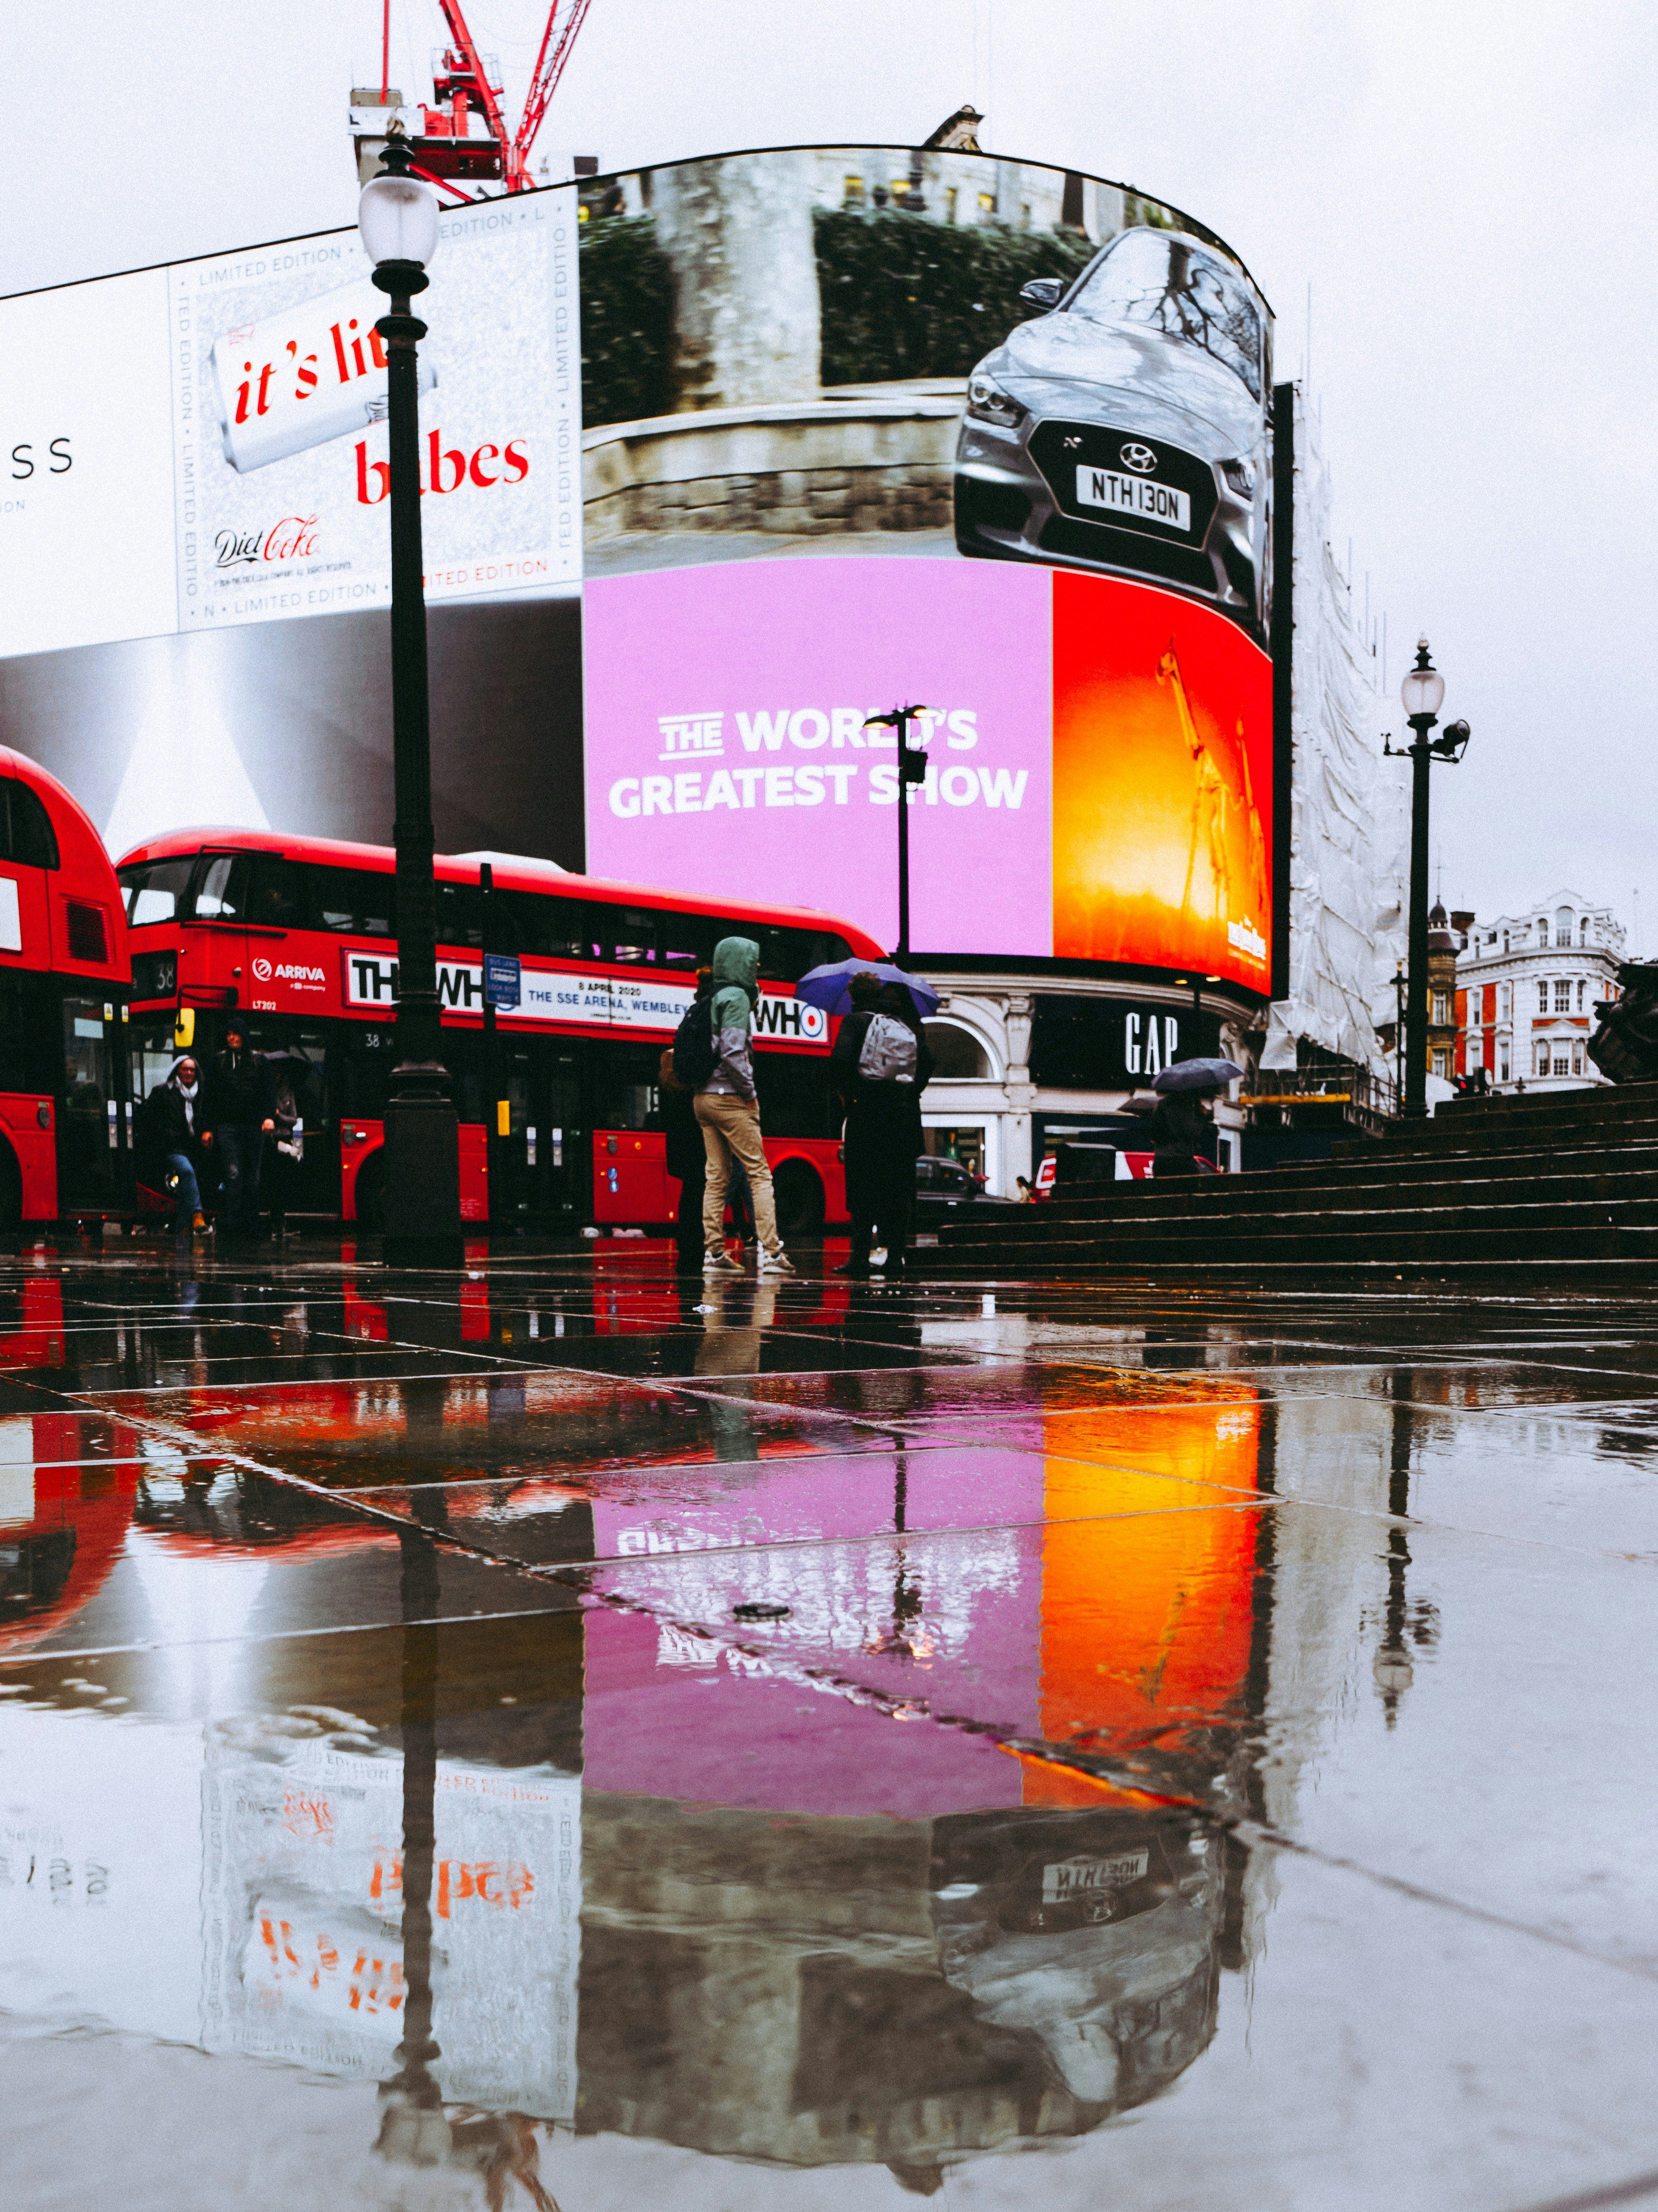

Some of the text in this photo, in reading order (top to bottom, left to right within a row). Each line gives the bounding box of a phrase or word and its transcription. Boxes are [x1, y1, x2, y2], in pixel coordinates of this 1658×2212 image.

[440, 213, 513, 239] EDITION
[199, 248, 341, 286] LIMITED EDITION
[555, 307, 568, 392] LIMITED
[180, 340, 192, 419] EDITION
[235, 340, 318, 424] it's
[354, 428, 529, 505] bbes
[558, 419, 570, 503] EDITION
[183, 444, 195, 524] LIMITED
[1093, 472, 1132, 506] NTH
[215, 514, 319, 566] Diet Coke
[476, 558, 548, 581] EDITION
[235, 593, 302, 613] LIMITED
[308, 583, 377, 604] EDITION
[660, 708, 979, 752] THE WORLD'S
[608, 764, 1029, 819] GREATEST SHOW
[275, 964, 326, 981] ARRIVA
[588, 983, 613, 994] APRIL
[618, 986, 642, 996] 2020
[529, 990, 552, 1003] THE
[557, 993, 580, 1005] SSE
[584, 995, 628, 1011] ARENA,
[365, 1033, 380, 1048] 38
[1125, 1012, 1179, 1076] GAP
